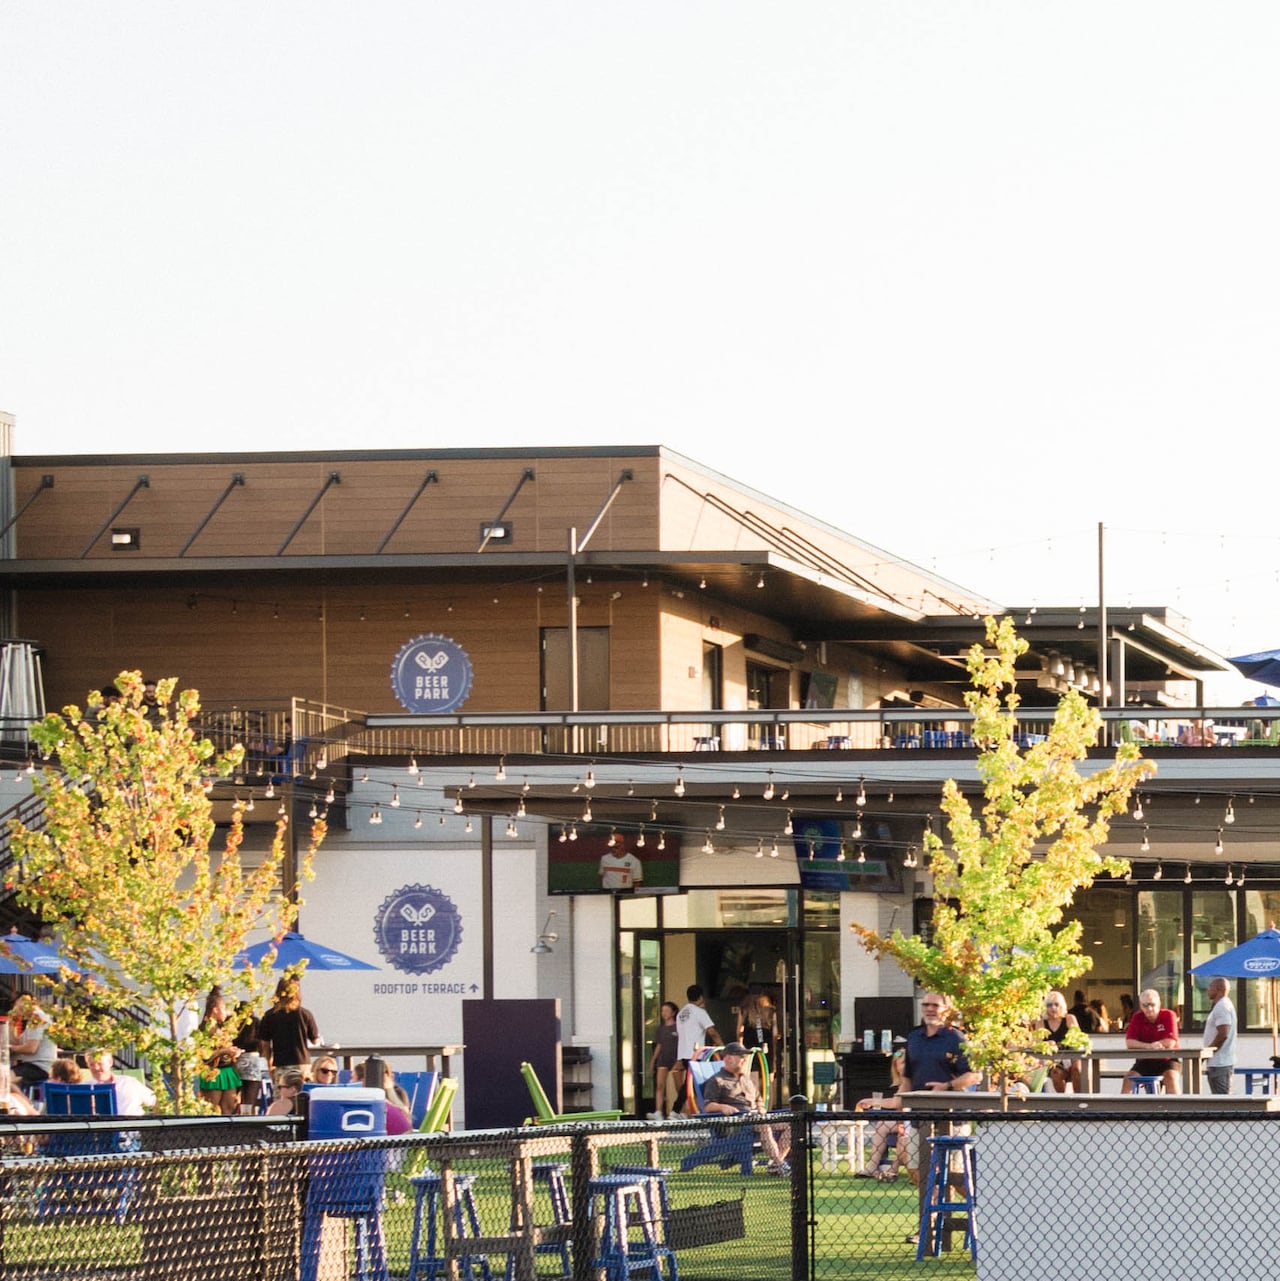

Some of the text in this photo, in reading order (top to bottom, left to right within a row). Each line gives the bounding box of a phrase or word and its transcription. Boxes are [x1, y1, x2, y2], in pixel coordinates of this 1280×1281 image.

[416, 675, 449, 688] BEER
[415, 688, 450, 700] PARK
[401, 929, 436, 942] BEER
[400, 942, 437, 955] PARK
[374, 983, 466, 995] ROOFTOP TERRACE
